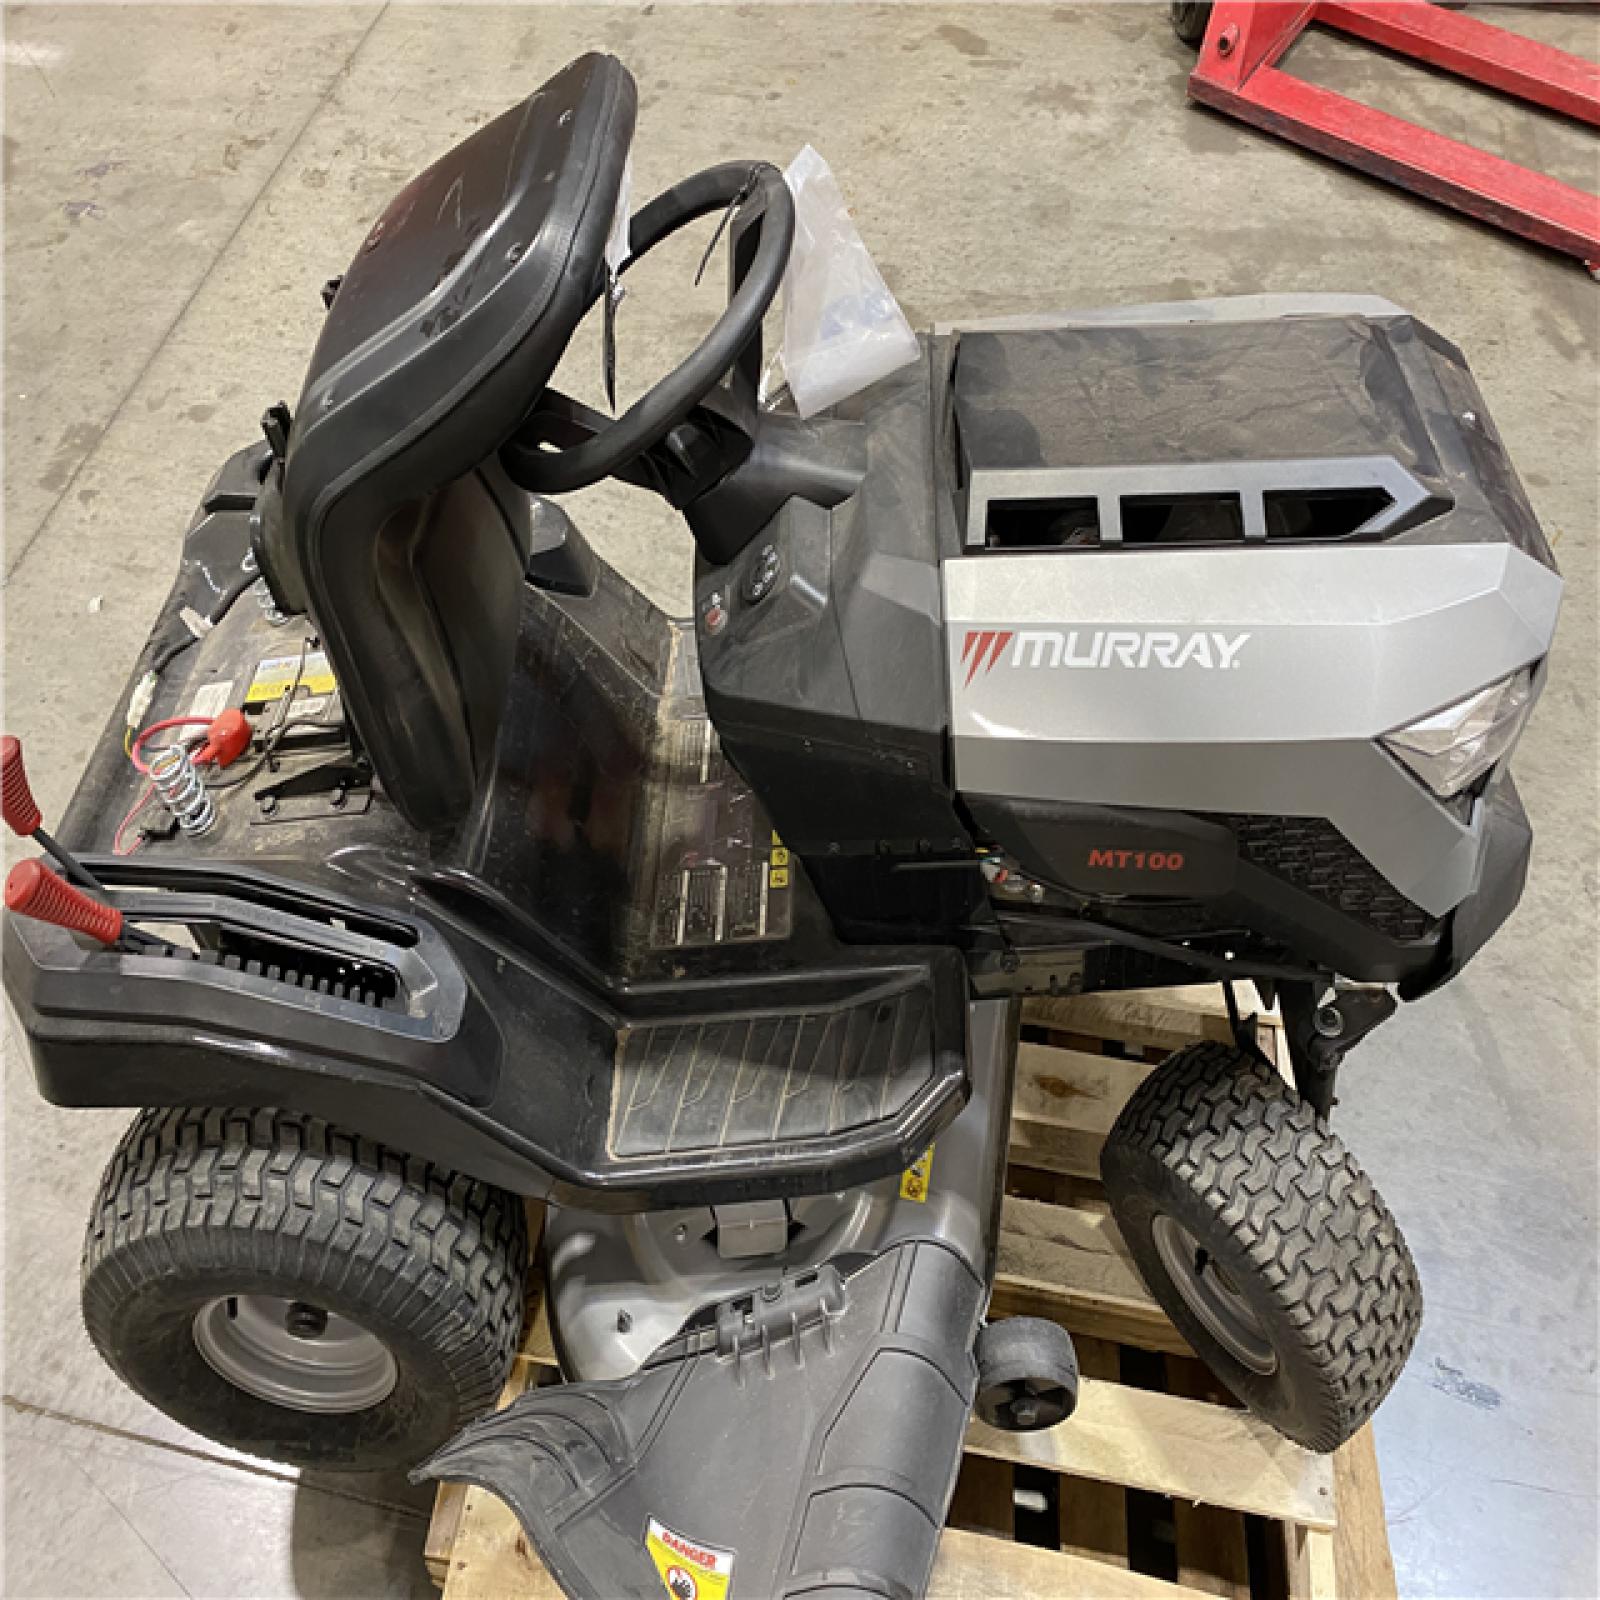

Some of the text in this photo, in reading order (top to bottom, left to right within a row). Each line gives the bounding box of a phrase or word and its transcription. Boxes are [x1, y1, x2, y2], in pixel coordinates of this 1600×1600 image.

[1011, 631, 1250, 669] MURRAY
[1087, 848, 1184, 871] MT100
[661, 1531, 717, 1569] DANGER
